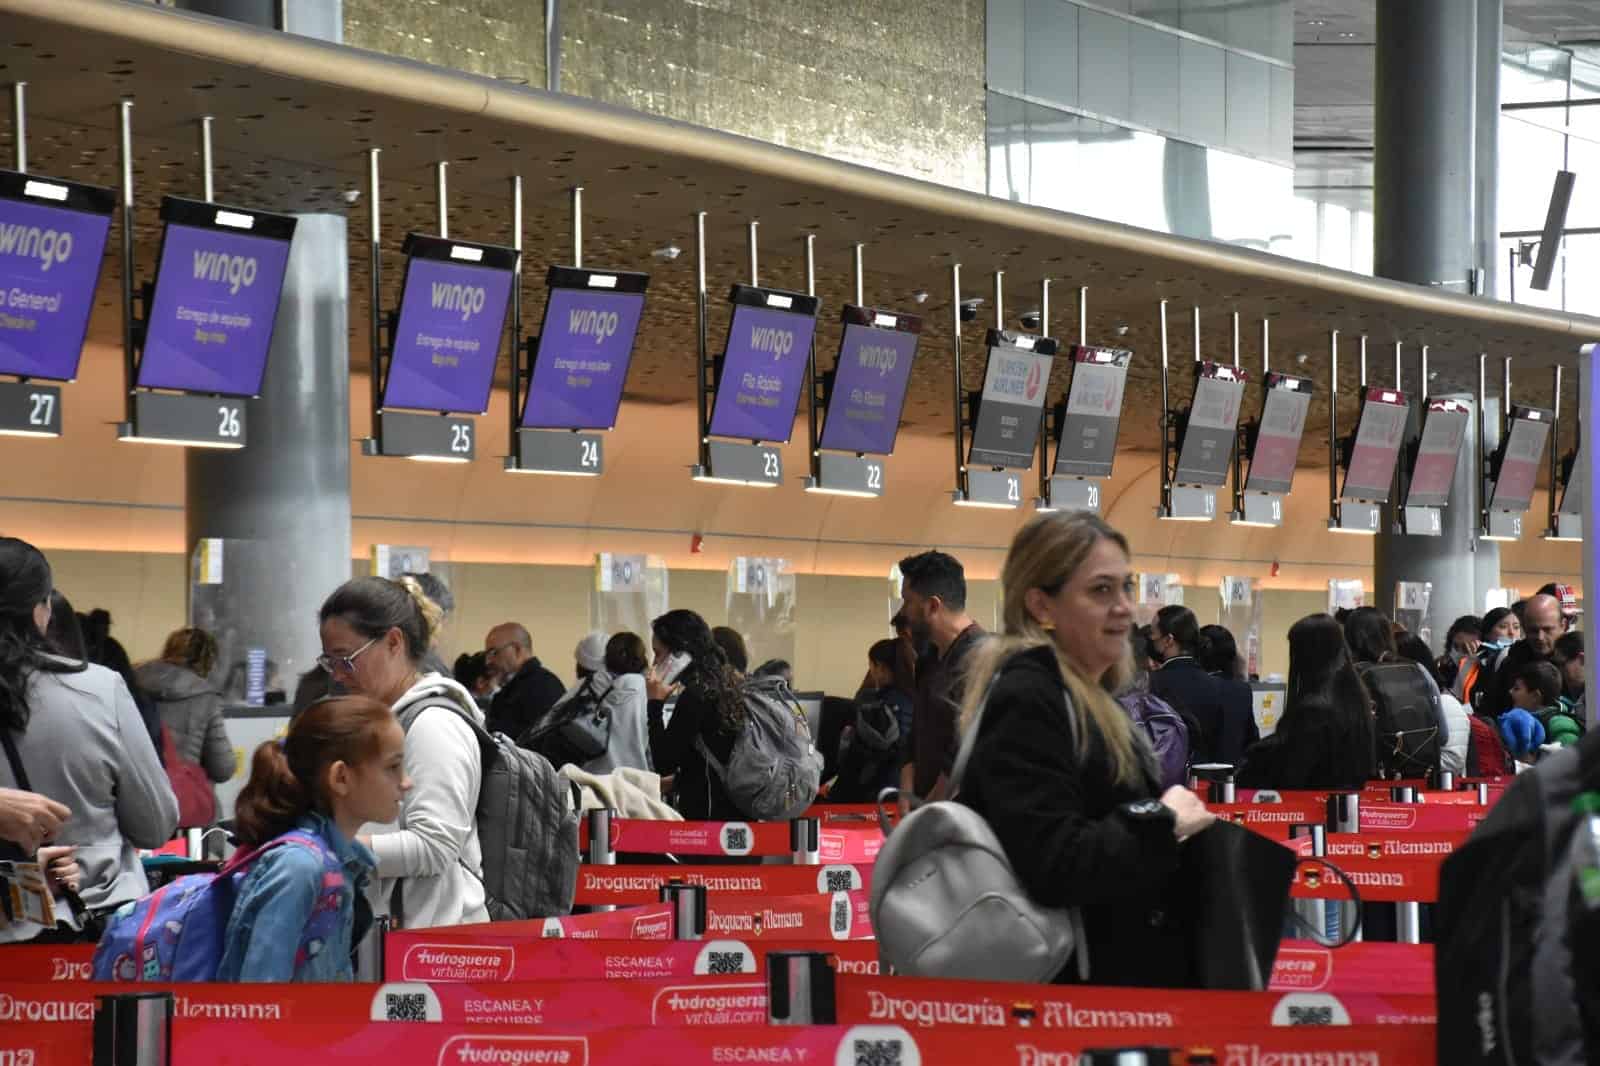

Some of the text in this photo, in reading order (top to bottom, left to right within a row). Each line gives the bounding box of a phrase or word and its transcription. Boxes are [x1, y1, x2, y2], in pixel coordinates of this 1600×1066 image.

[0, 222, 73, 271] wingo
[192, 249, 257, 294] wingo
[8, 287, 61, 312] General
[431, 282, 486, 320] wingo
[569, 309, 619, 344] wingo
[751, 326, 792, 360] wingo
[859, 345, 897, 376] wingo
[29, 394, 55, 425] 27
[218, 407, 241, 437] 26
[451, 425, 470, 452] 25
[581, 441, 599, 467] 24
[763, 452, 779, 477] 23
[867, 465, 881, 489] 22
[1007, 479, 1019, 501] 21
[1088, 486, 1098, 508] 20
[1272, 500, 1281, 520] 18
[1247, 809, 1305, 822] Alemana
[1384, 840, 1453, 854] Alemana
[687, 873, 762, 890] Alemana
[1322, 866, 1404, 886] Amana
[763, 909, 803, 928] Alemana
[605, 955, 675, 968] ESCANEA Y
[0, 992, 95, 1021] Drogue
[464, 999, 544, 1012] ESCANEA Y
[1043, 1001, 1174, 1028] Alemana
[712, 1046, 808, 1063] ESCANEA Y
[1225, 1044, 1381, 1066] Alemana
